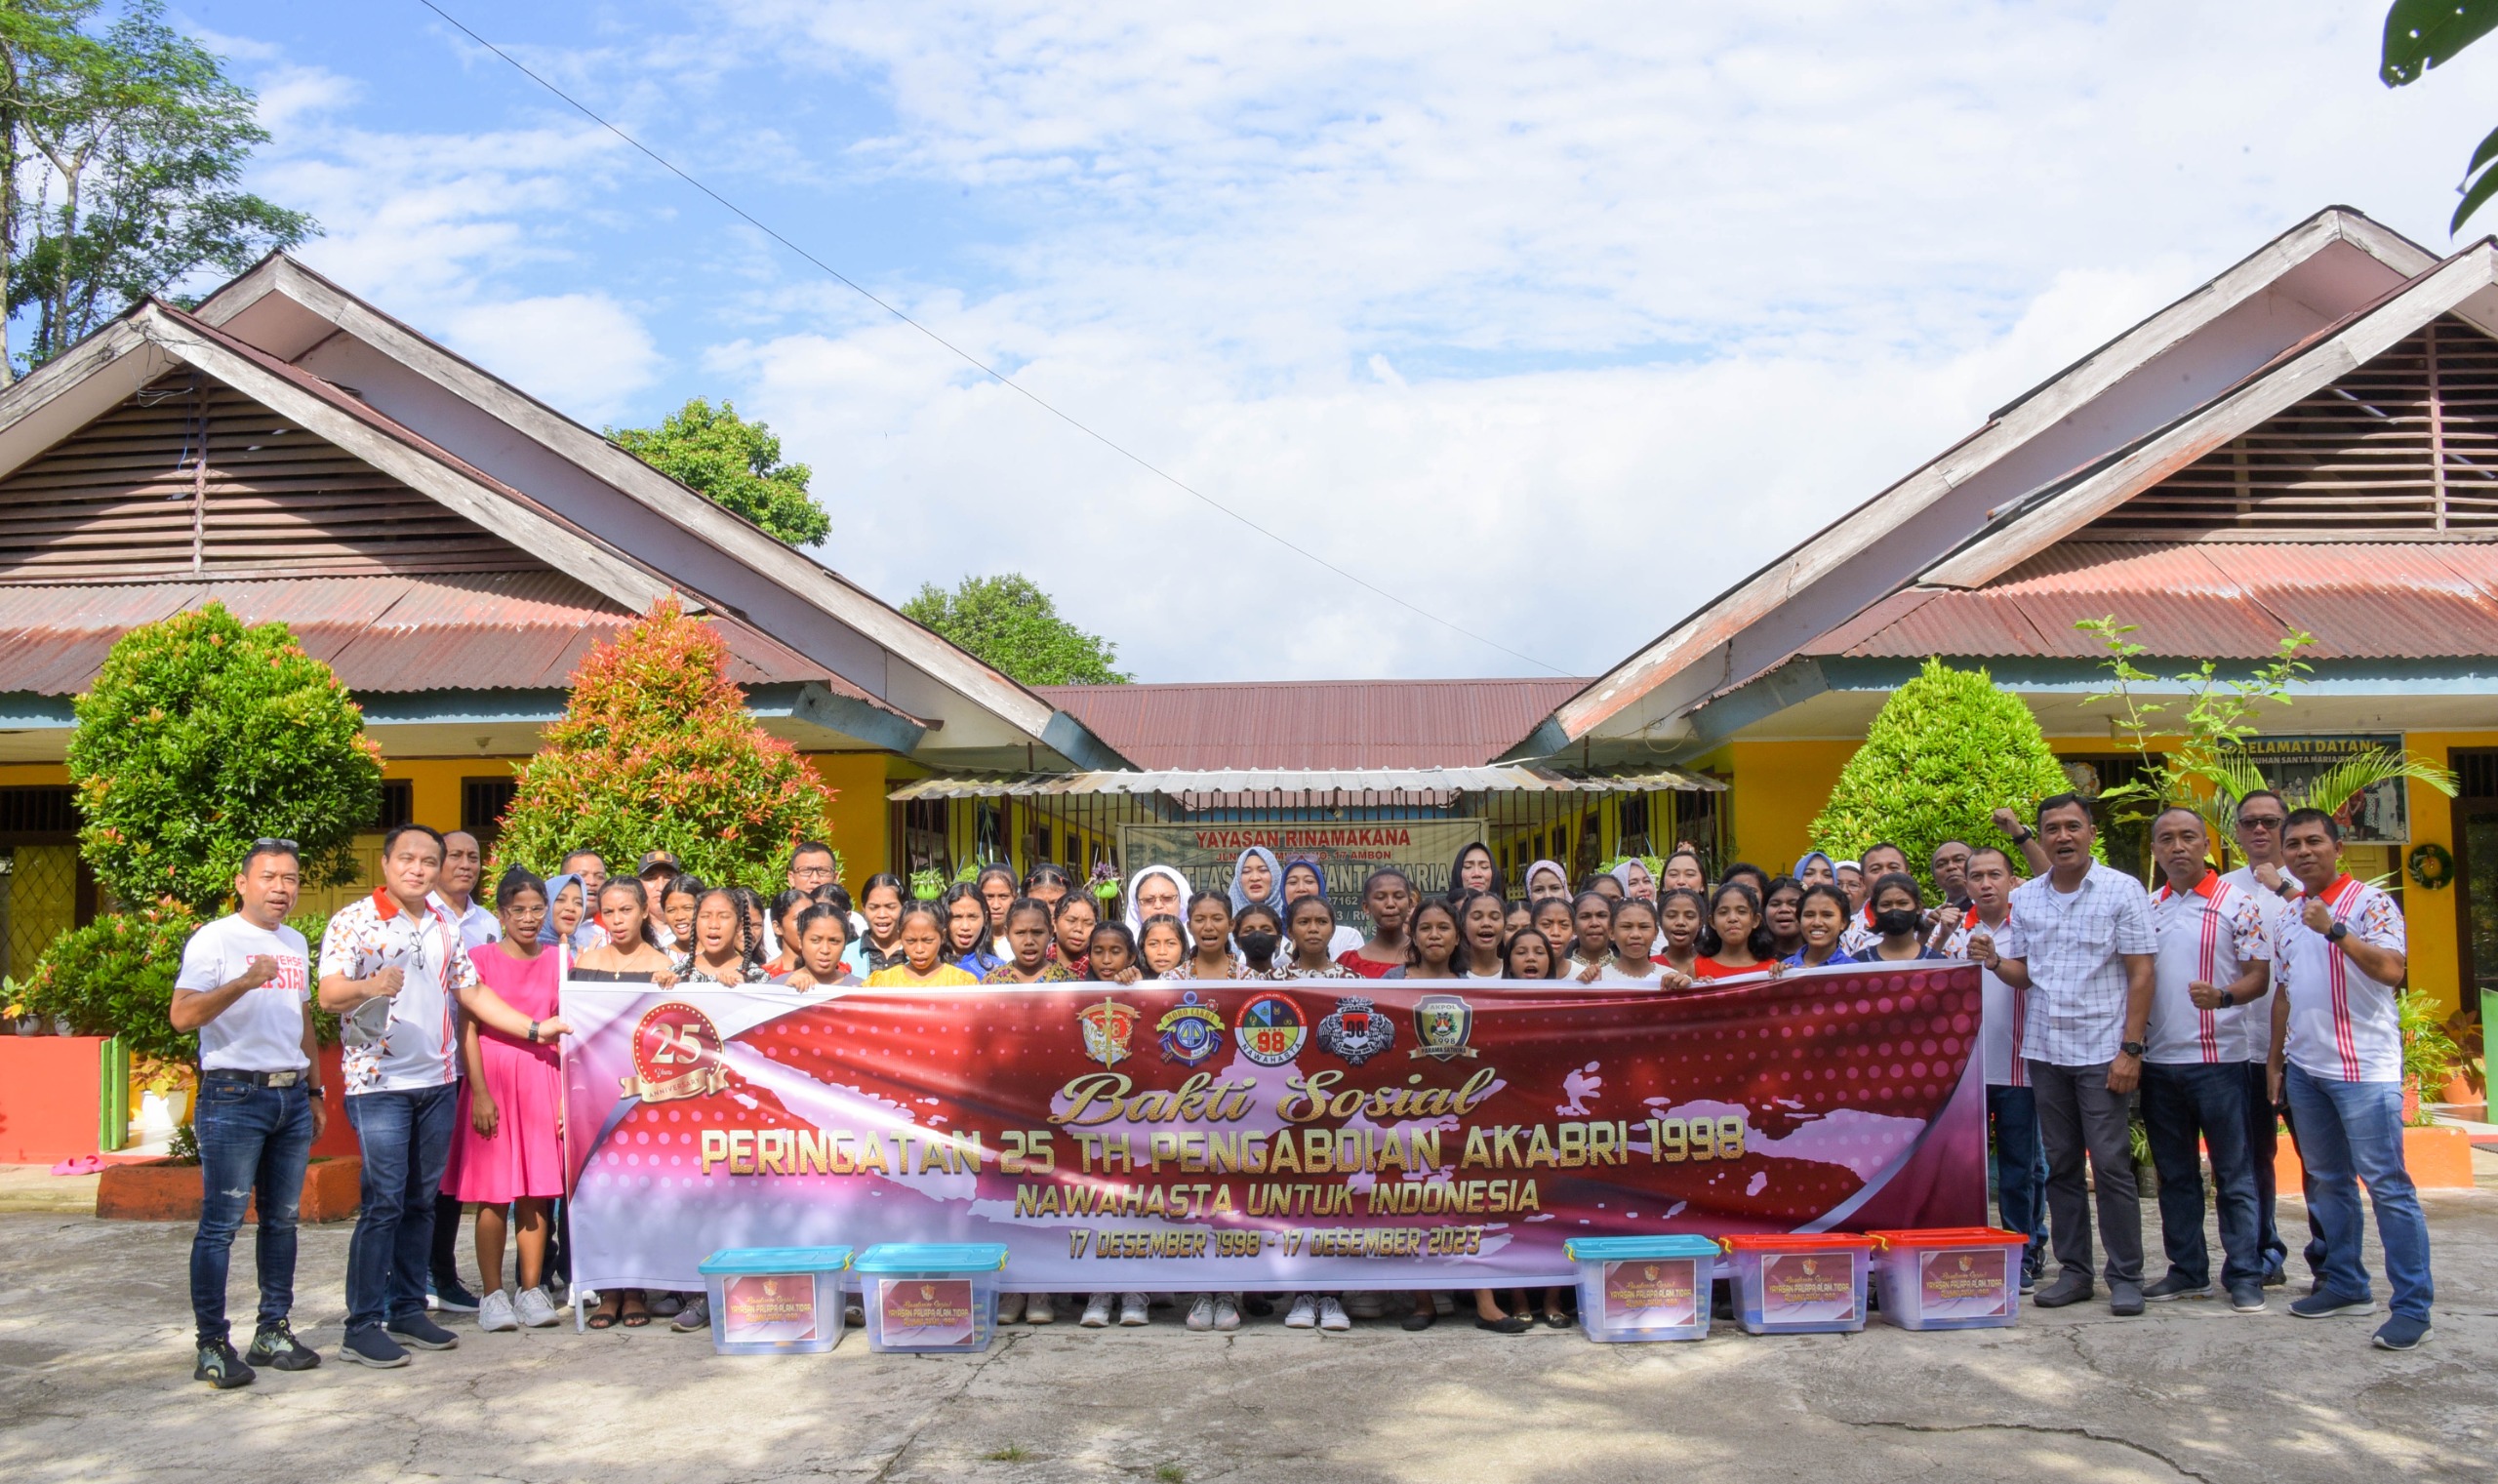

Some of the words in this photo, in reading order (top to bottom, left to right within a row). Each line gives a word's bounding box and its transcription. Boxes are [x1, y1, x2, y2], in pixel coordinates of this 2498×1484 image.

[2239, 740, 2312, 754] SELAMAT
[2281, 755, 2309, 764] SANTA
[1195, 830, 1280, 849] YAYASAN
[1284, 828, 1411, 848] RINAMAKANA
[1335, 851, 1348, 861] 17
[1350, 851, 1391, 861] AMBON
[1384, 862, 1452, 894] ARIA
[1165, 1009, 1189, 1023] MORO
[1190, 1008, 1216, 1023] CAKRA
[1346, 1020, 1365, 1038] 98
[649, 1023, 702, 1064] 25
[1241, 1042, 1302, 1063] NAWAHASTA
[1257, 1031, 1285, 1053] 98
[655, 1068, 673, 1078] Years
[649, 1077, 701, 1099] ANNIVERSARY
[1047, 1071, 1257, 1125] Bakti
[1276, 1066, 1496, 1122] Sosial
[701, 1129, 982, 1176] PERINGATAN
[999, 1129, 1056, 1175] 25
[1073, 1130, 1132, 1176] TH
[1149, 1126, 1441, 1176] PENGABDIAN
[1460, 1119, 1629, 1170] AKABRI
[1644, 1114, 1746, 1164] 1998
[1014, 1183, 1233, 1218] NAWAHASTA
[1246, 1182, 1357, 1217] UNTUK
[1366, 1178, 1541, 1217] INDONESIA
[1069, 1228, 1091, 1259] 17
[1095, 1228, 1207, 1259] DESEMBER
[1215, 1227, 1262, 1258] 1998
[1282, 1227, 1304, 1257] 17
[1309, 1226, 1421, 1258] DESEMBER
[1427, 1225, 1482, 1256] 2023
